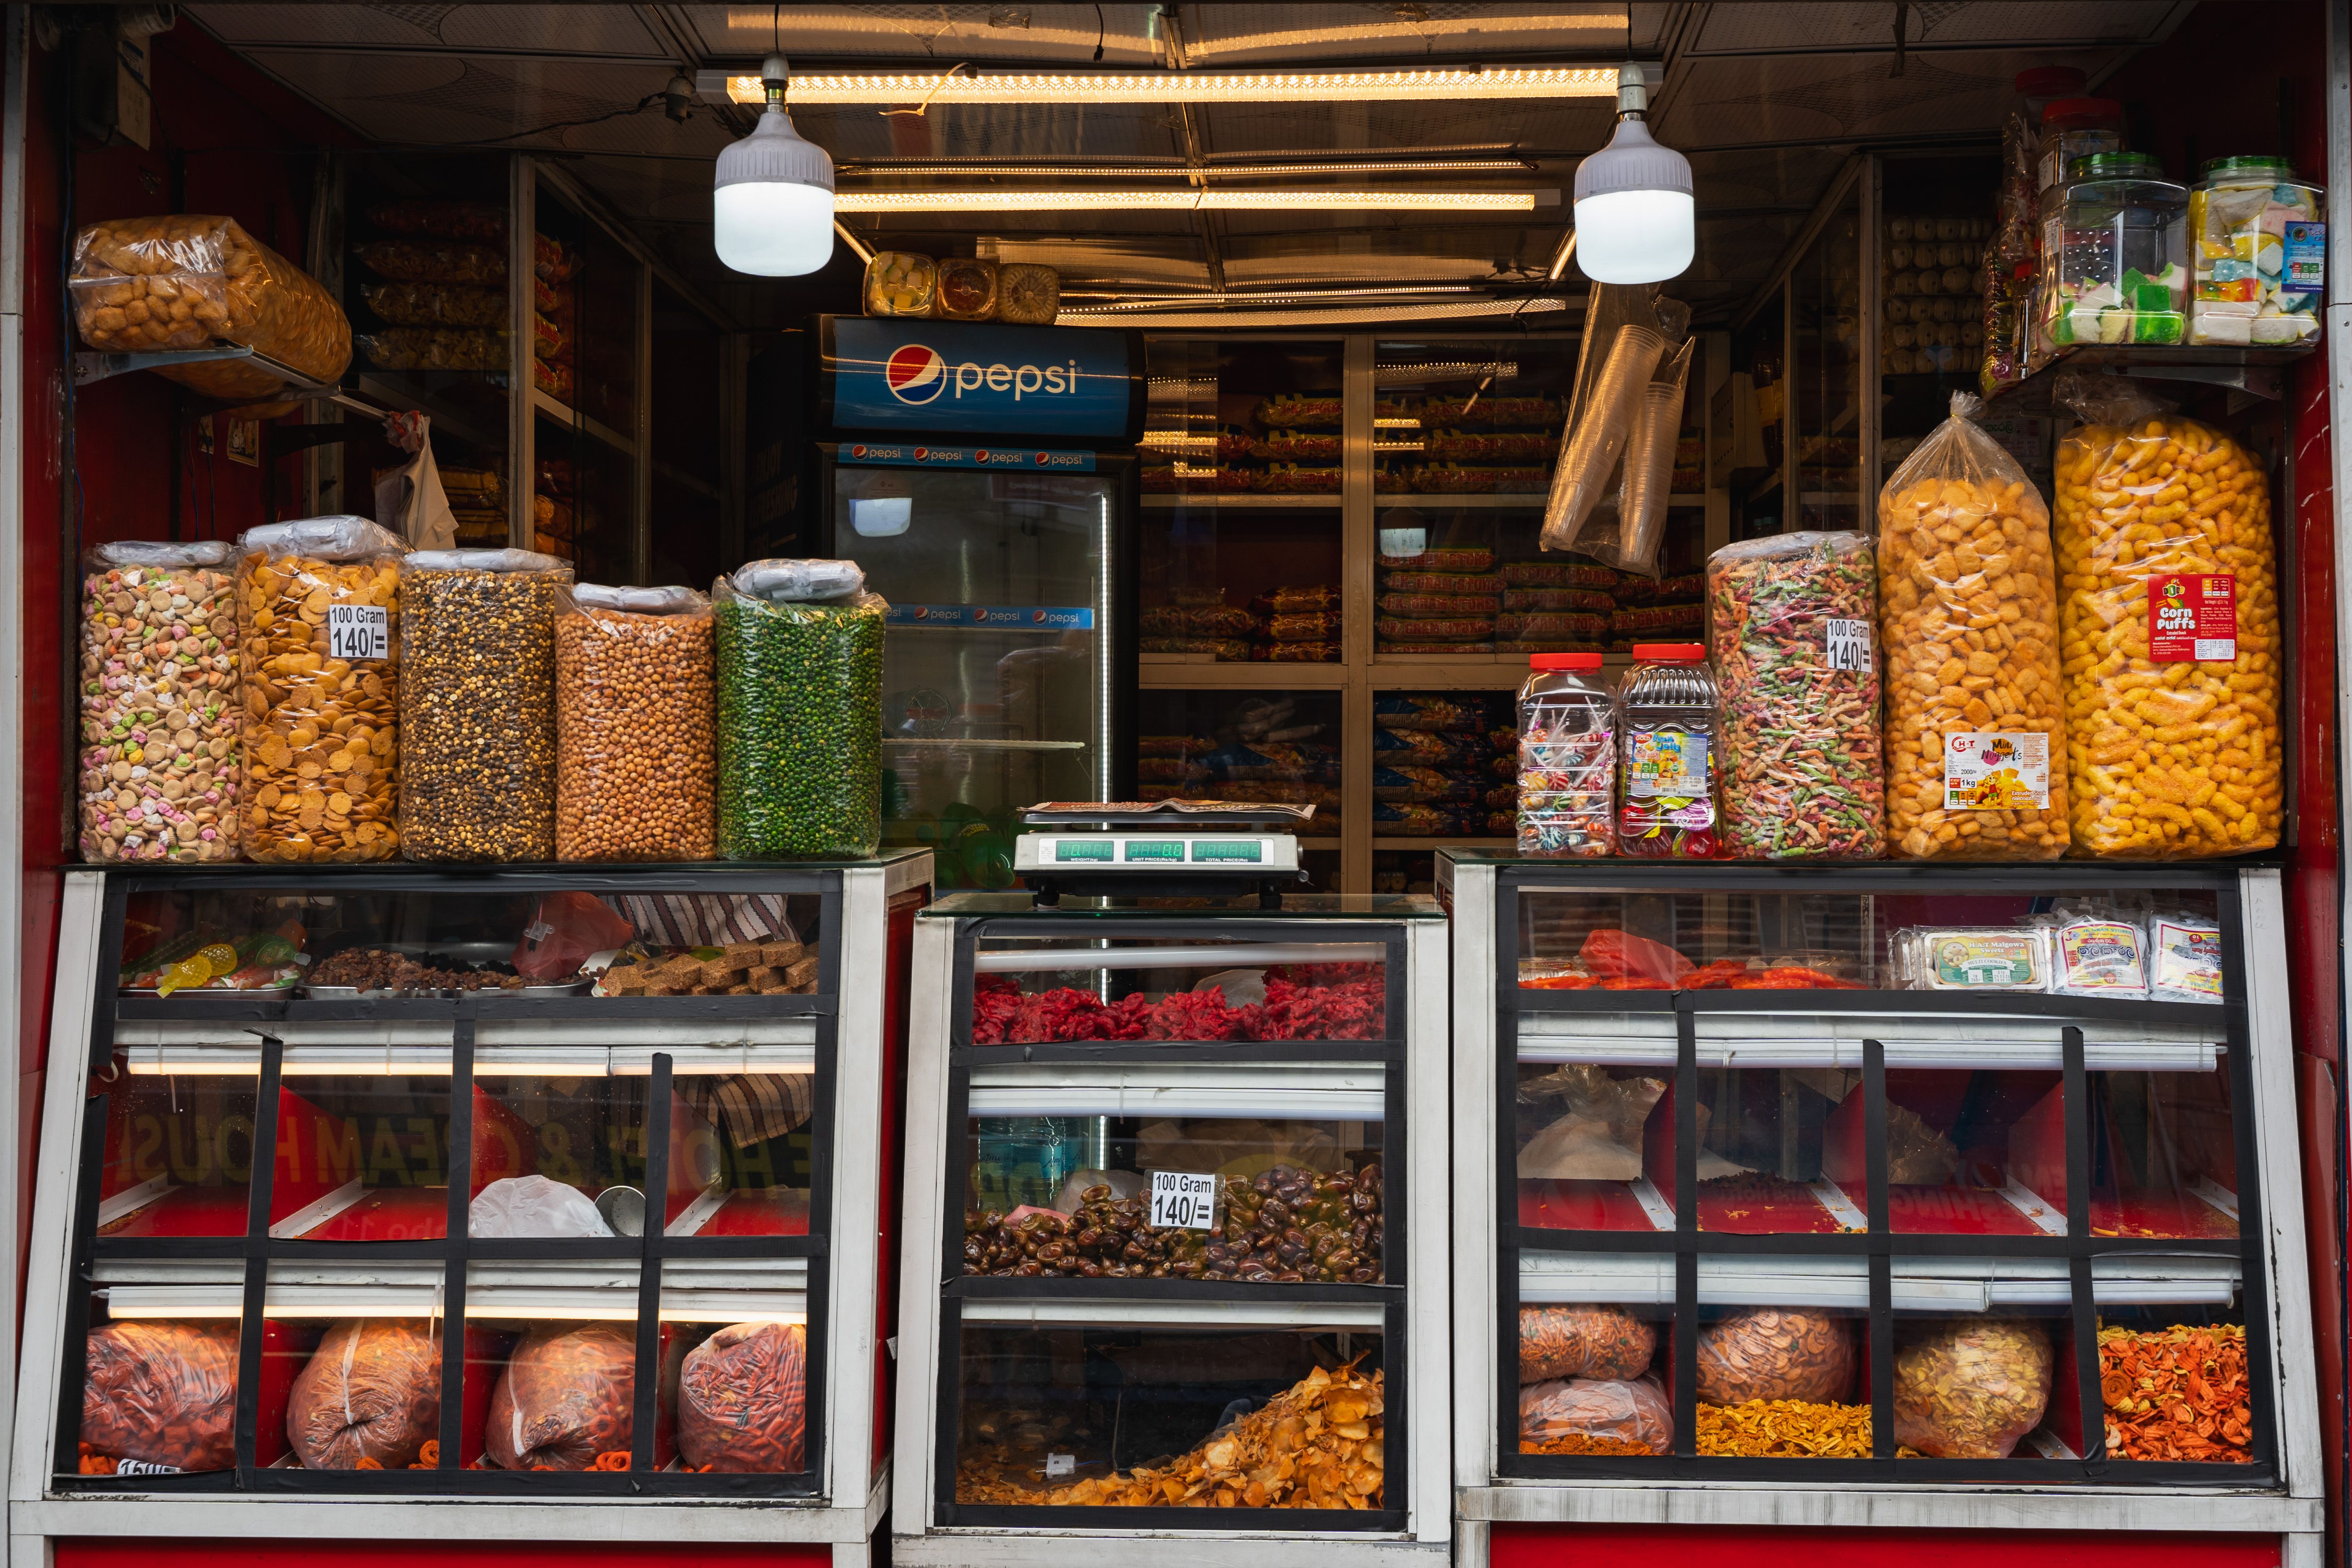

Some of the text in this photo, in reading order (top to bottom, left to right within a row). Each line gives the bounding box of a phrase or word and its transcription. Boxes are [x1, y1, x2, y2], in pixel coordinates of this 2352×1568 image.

[955, 359, 1076, 401] pepsi
[870, 447, 1083, 465] pepsi pepsi pepsi pepsi
[332, 607, 384, 624] 100 Gram
[931, 610, 962, 620] pepsi
[990, 611, 1021, 622] pepsi
[1049, 613, 1079, 624] pepsi
[2160, 607, 2192, 618] Corn
[1829, 620, 1869, 639] 100 Gram
[2157, 617, 2195, 630] Puffs
[334, 627, 385, 656] 140/=
[1830, 641, 1870, 670] 140/=
[1981, 747, 2022, 761] Nuggets
[1992, 739, 2014, 751] Mini
[1155, 1174, 1211, 1193] 100 Gram
[1155, 1194, 1209, 1226] 140/=
